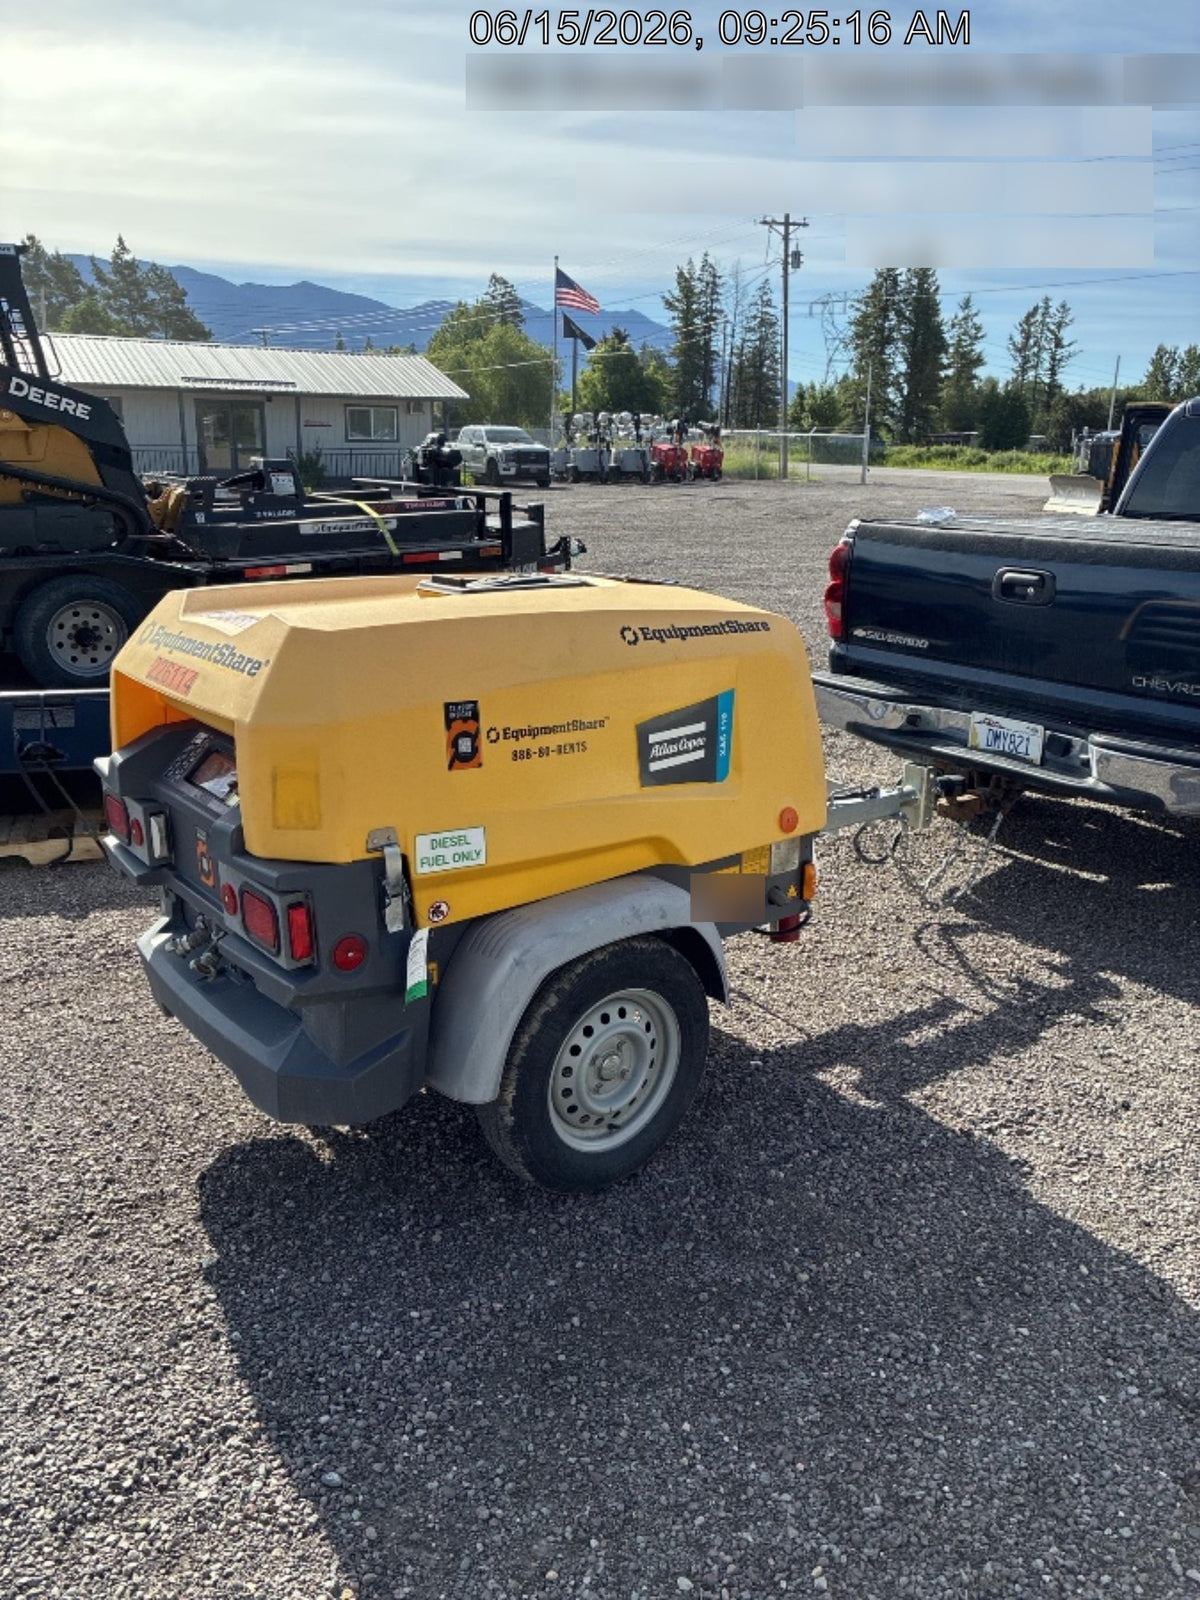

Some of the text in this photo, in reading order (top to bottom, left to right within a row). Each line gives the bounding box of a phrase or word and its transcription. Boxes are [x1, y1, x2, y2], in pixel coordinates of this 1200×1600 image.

[8, 376, 92, 420] DEERE
[638, 619, 771, 643] EquipmentShare
[865, 630, 929, 649] SILVERADO
[150, 624, 262, 677] EquipmentShare
[502, 717, 606, 743] EquipmentShare
[985, 727, 1031, 756] DMY821
[649, 742, 678, 760] Atlas
[430, 834, 472, 851] DIESEL
[420, 848, 482, 869] FUEL ONLY
